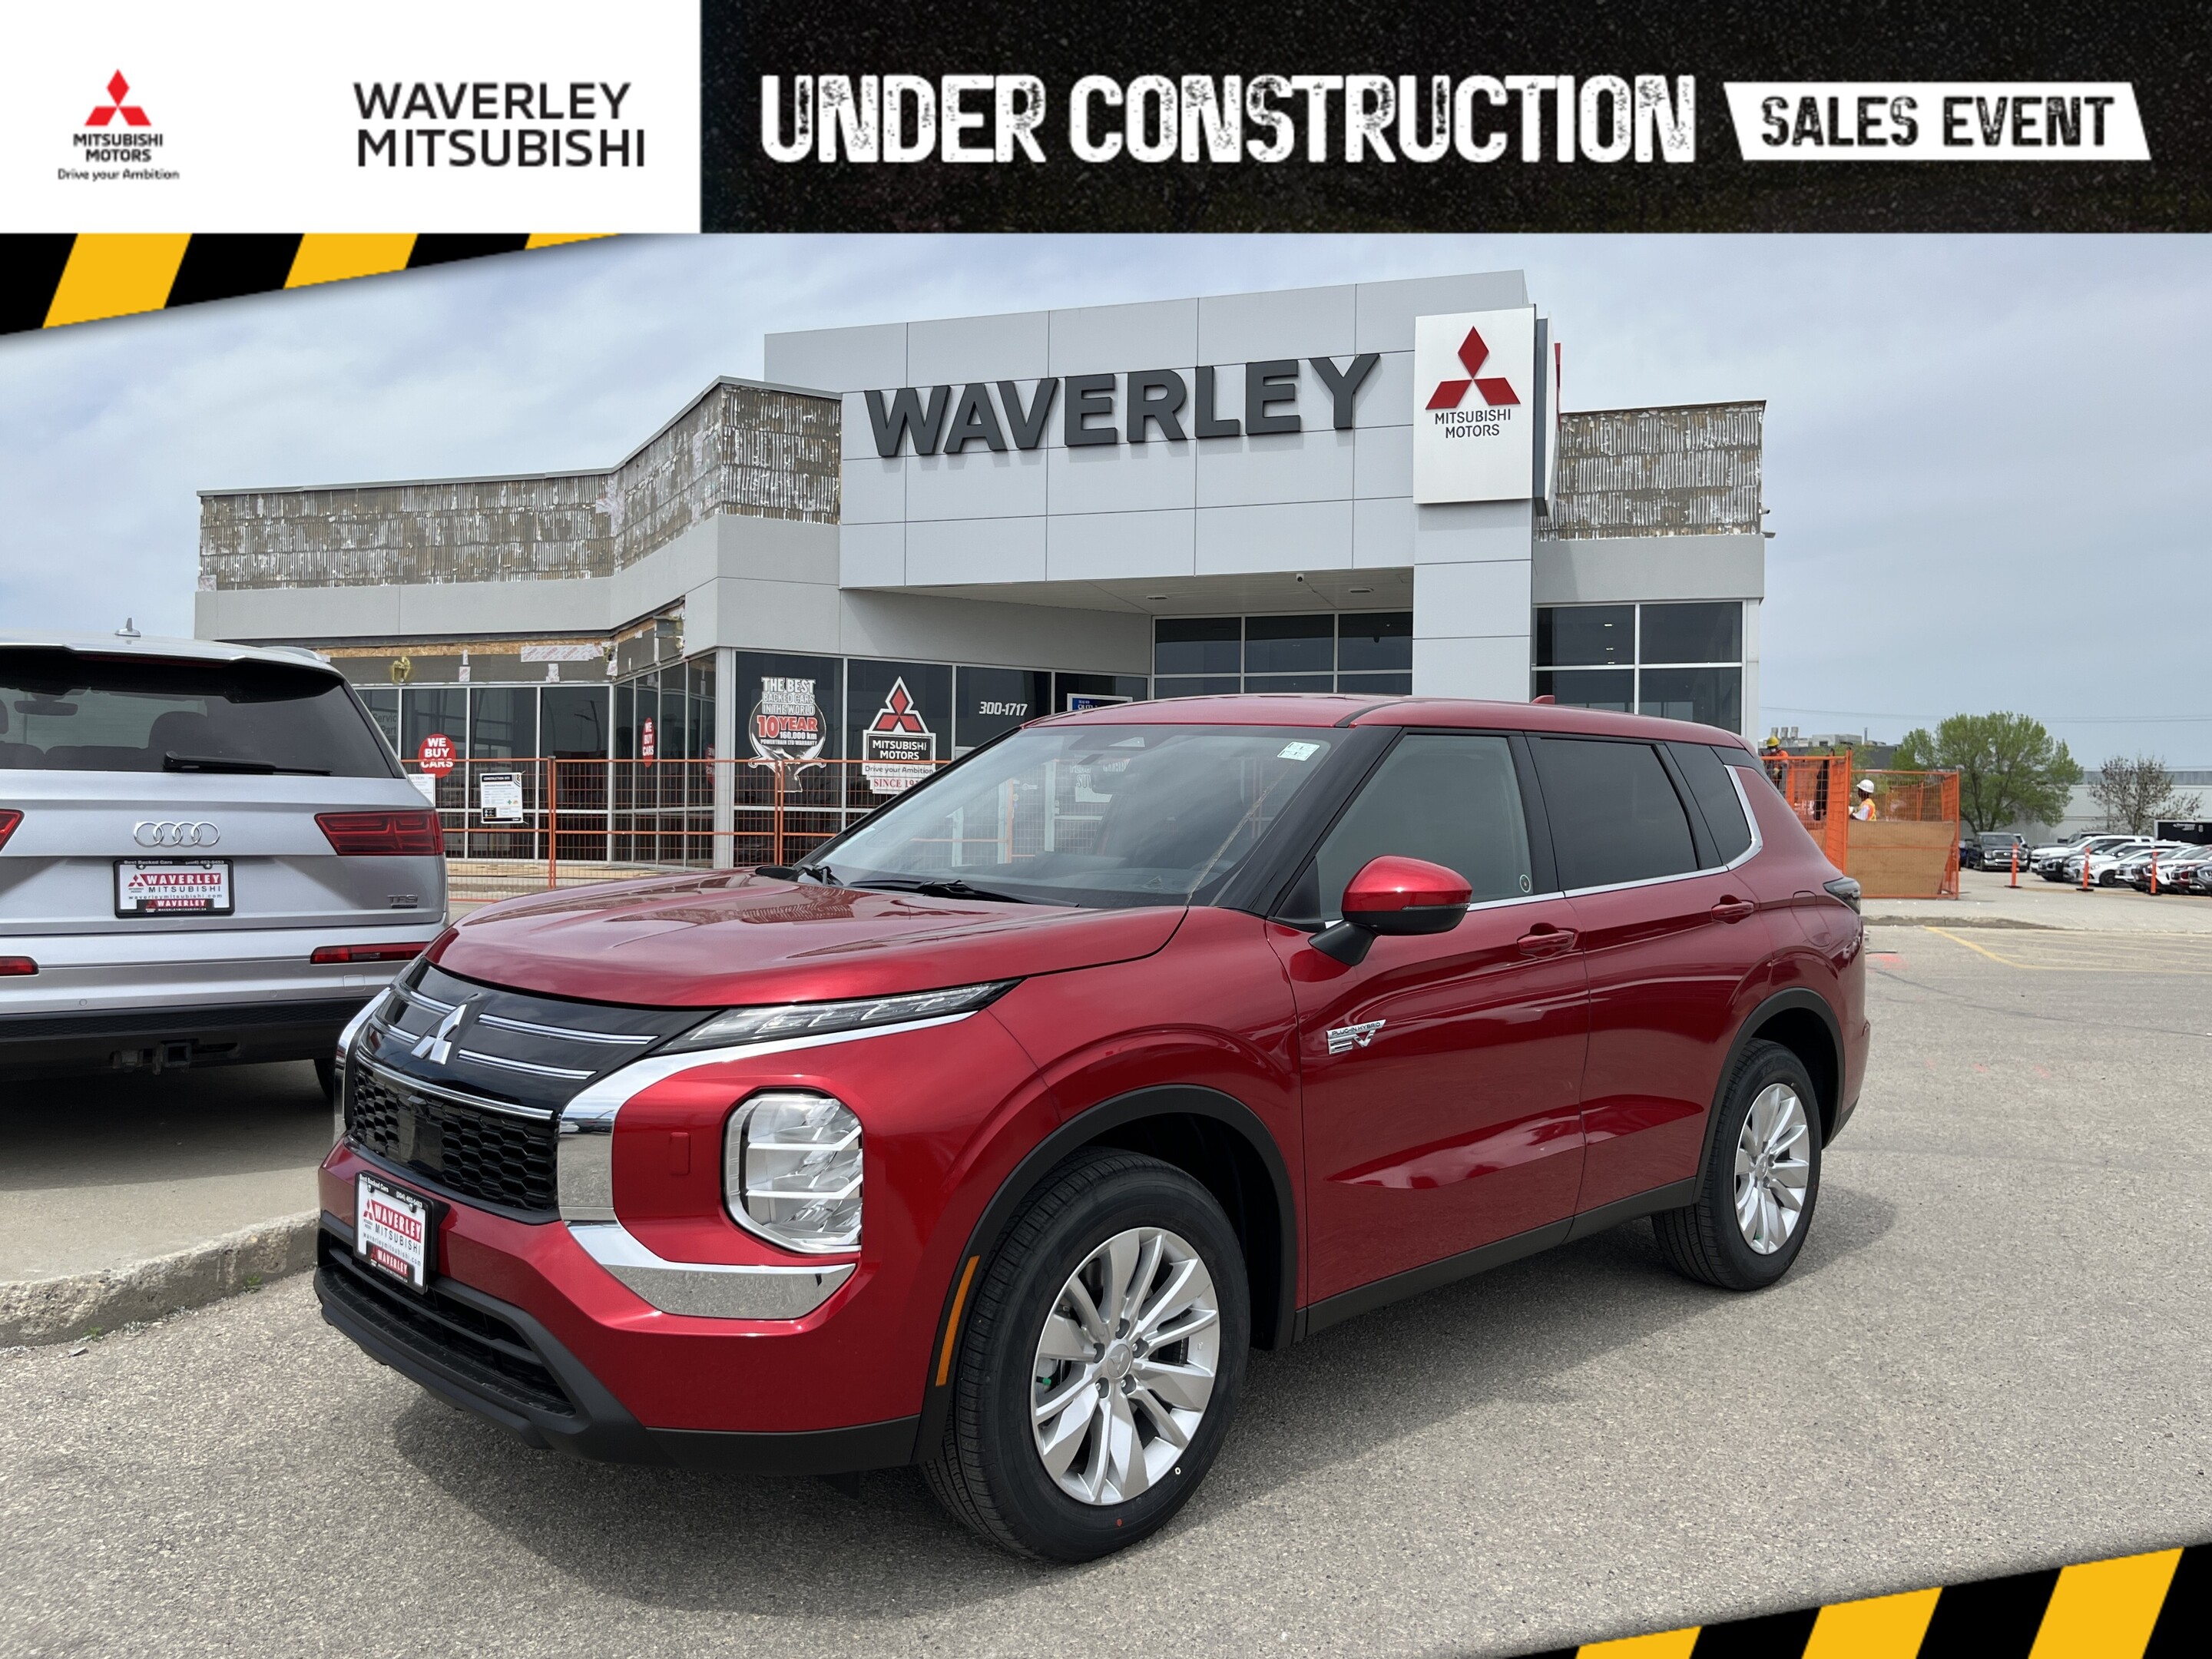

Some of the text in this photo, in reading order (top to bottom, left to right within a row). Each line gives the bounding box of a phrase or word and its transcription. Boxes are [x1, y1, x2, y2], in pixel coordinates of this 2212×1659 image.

[865, 353, 1380, 457] WAVERLEY
[1435, 408, 1512, 425] MITSUBISHI
[1445, 423, 1501, 439] MOTORS
[762, 677, 816, 694] THE BEST
[763, 692, 815, 704] BACKED CARS
[763, 704, 815, 715] IN THE WORLD
[979, 701, 1028, 717] 300-1717
[373, 713, 397, 723] Servic
[381, 725, 397, 734] Part
[646, 722, 653, 733] WE
[757, 715, 818, 738] 10 YEAR
[644, 733, 653, 745] BUY
[780, 731, 806, 740] 160,000
[427, 738, 446, 747] WE
[873, 740, 926, 751] MITSUBISHI
[425, 748, 449, 758] BUY
[643, 745, 654, 756] CARS
[880, 750, 919, 760] MOTORS
[420, 758, 453, 768] CARS
[874, 779, 902, 788] SINCE
[147, 874, 220, 885] WAVERLEY
[374, 1204, 422, 1240] WAVERLEY
[375, 1224, 421, 1255] MITSUBISHI
[363, 1233, 422, 1267] waverleymitsubishi.com
[377, 1249, 408, 1275] WAVERLEY
